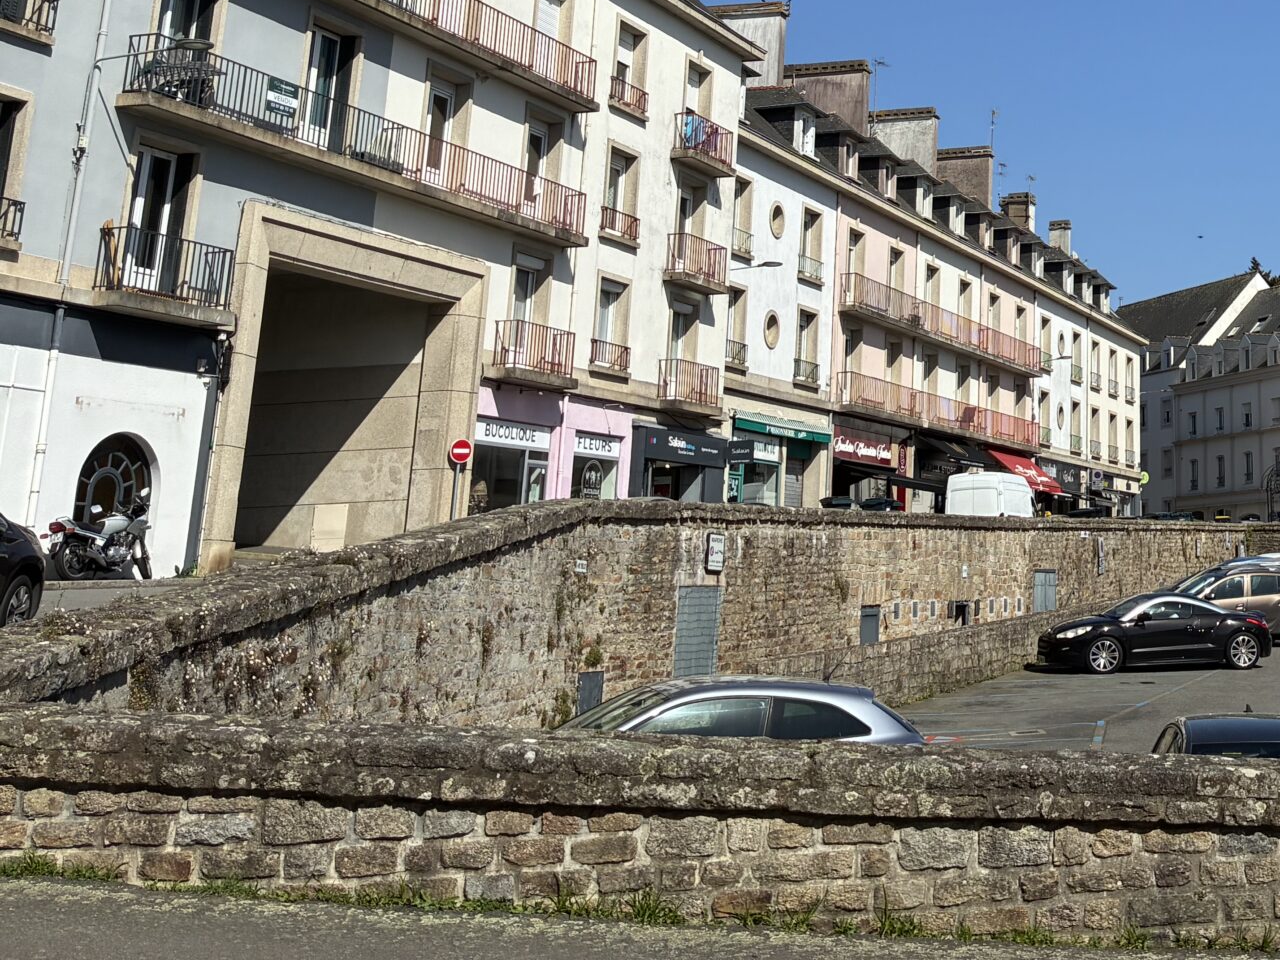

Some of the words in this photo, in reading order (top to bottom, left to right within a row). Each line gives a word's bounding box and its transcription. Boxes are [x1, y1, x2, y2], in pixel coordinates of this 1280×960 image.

[273, 93, 293, 106] VENDU
[484, 423, 537, 443] BUCOLIQUE
[577, 436, 613, 453] FLEURS
